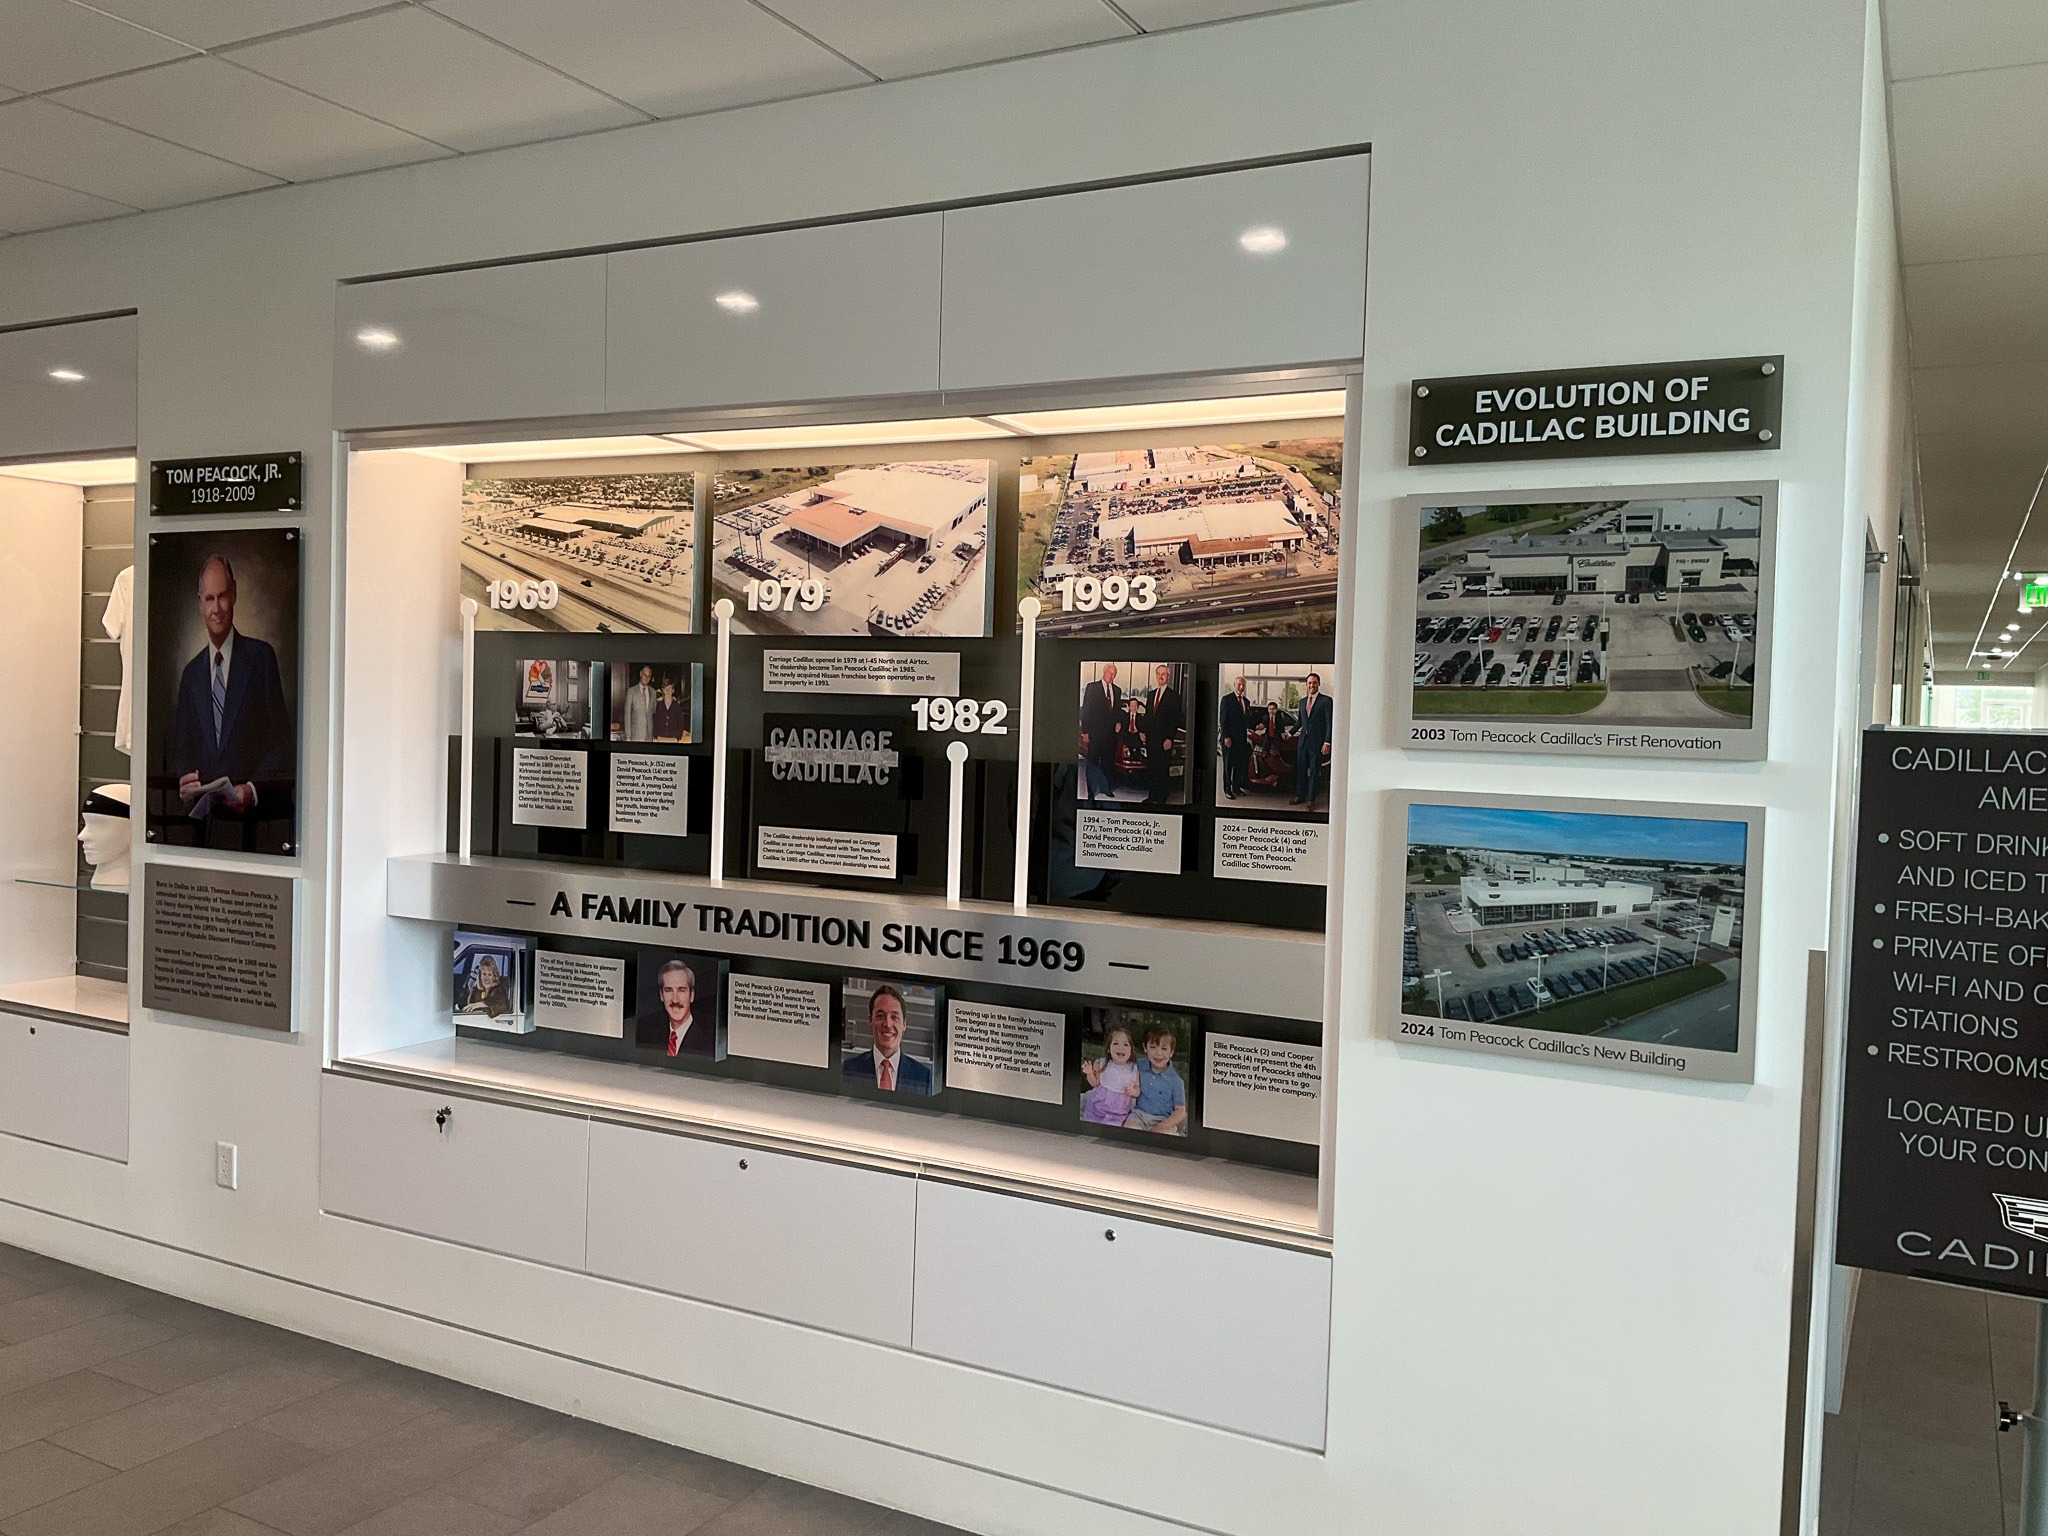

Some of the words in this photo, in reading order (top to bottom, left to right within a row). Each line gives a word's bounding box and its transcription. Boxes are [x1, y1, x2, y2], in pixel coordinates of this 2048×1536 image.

[1475, 379, 1654, 414] EVOLUTION
[1665, 377, 1709, 401] OF
[1435, 416, 1585, 447] CADILLAC
[1595, 407, 1750, 439] BUILDING
[166, 469, 193, 484] TOM
[197, 465, 260, 482] PEACOCK,
[264, 463, 281, 482] JR.
[191, 485, 255, 503] 1918-2009
[485, 579, 559, 610] 1969
[742, 579, 824, 612] 1979
[1056, 575, 1157, 612] 1993
[780, 664, 807, 672] dealership
[815, 657, 836, 665] opened
[796, 672, 820, 680] acquired
[887, 674, 915, 682] operating
[911, 698, 1008, 734] 1982
[771, 727, 892, 752] CARRIAGE
[1411, 728, 1446, 740] 2003
[1449, 729, 1478, 742] Tom
[1481, 730, 1536, 744] Peacock
[1540, 732, 1602, 745] Cadillac's
[1607, 734, 1637, 747] First
[1641, 735, 1721, 749] Renovation
[1892, 746, 2047, 774] CADILLAC
[772, 761, 890, 785] CADILLAC
[1978, 786, 2048, 811] AME
[1098, 826, 1113, 834] Tom
[1113, 827, 1142, 835] Peacock
[1142, 829, 1152, 837] (4)
[1153, 829, 1167, 837] and
[1107, 818, 1121, 826] Tom
[1121, 819, 1152, 828] Peacock,
[1152, 821, 1160, 829] Jr.
[1223, 825, 1240, 833] 2024
[1247, 827, 1268, 835] David
[1270, 828, 1300, 837] Peacock
[1097, 843, 1125, 851] Peacock
[1126, 845, 1153, 853] Cadillac
[1102, 835, 1130, 843] Peacock
[1131, 837, 1144, 845] (37)
[1222, 834, 1248, 843] Cooper
[1249, 836, 1279, 844] Peacock
[1281, 838, 1290, 846] (4)
[1292, 838, 1306, 846] and
[1239, 844, 1268, 852] Peacock
[1270, 846, 1284, 854] (34)
[1295, 847, 1306, 855] the
[1899, 829, 1968, 852] SOFT
[1082, 851, 1120, 859] Showroom.
[1221, 851, 1247, 860] current
[1248, 853, 1264, 861] Tom
[1265, 854, 1296, 863] Peacock
[1221, 860, 1249, 869] Cadillac
[1251, 862, 1292, 872] Showroom.
[1897, 865, 1955, 887] AND
[1964, 868, 2026, 892] ICED
[1895, 900, 2048, 930] FRESH-BAK
[550, 891, 573, 917] A
[581, 893, 686, 928] FAMILY
[693, 903, 870, 948] TRADITION
[882, 923, 984, 961] SINCE
[997, 934, 1085, 972] 1969
[1894, 936, 1999, 963] PRIVATE
[2008, 944, 2048, 967] OF
[1893, 971, 1956, 996] WI-FI
[1964, 978, 2024, 1002] AND
[955, 1008, 981, 1019] Growing
[996, 1014, 1007, 1022] the
[1007, 1015, 1027, 1025] family
[1892, 1007, 2018, 1039] STATIONS
[1213, 1042, 1228, 1050] Ellie
[1229, 1044, 1259, 1054] Peacock
[1259, 1048, 1270, 1057] (2)
[1271, 1049, 1286, 1058] and
[1287, 1051, 1314, 1062] Cooper
[1400, 1022, 1435, 1037] 2024
[1438, 1026, 1466, 1041] Tom
[1470, 1031, 1524, 1048] Peacock
[1594, 1045, 1626, 1060] New
[1630, 1050, 1686, 1070] Building
[1212, 1059, 1251, 1072] generation
[1261, 1066, 1295, 1077] Peacocks
[1213, 1050, 1242, 1061] Peacock
[1243, 1054, 1253, 1064] (4)
[1253, 1056, 1288, 1069] represent
[1289, 1061, 1302, 1069] the
[1303, 1063, 1316, 1071] 4th
[1212, 1068, 1228, 1078] they
[1229, 1070, 1246, 1079] have
[1254, 1073, 1268, 1082] few
[1269, 1077, 1289, 1087] years
[1290, 1078, 1299, 1086] to
[1300, 1081, 1310, 1089] go
[1212, 1077, 1235, 1087] before
[1236, 1080, 1252, 1091] they
[1253, 1083, 1267, 1093] join
[1268, 1085, 1280, 1093] the
[1281, 1088, 1317, 1100] company.
[1888, 1098, 2014, 1133] LOCATED
[2025, 1114, 2048, 1138] U
[1900, 1132, 1977, 1163] YOUR
[1986, 1144, 2048, 1172] CON
[1897, 1231, 2048, 1276] CADI
